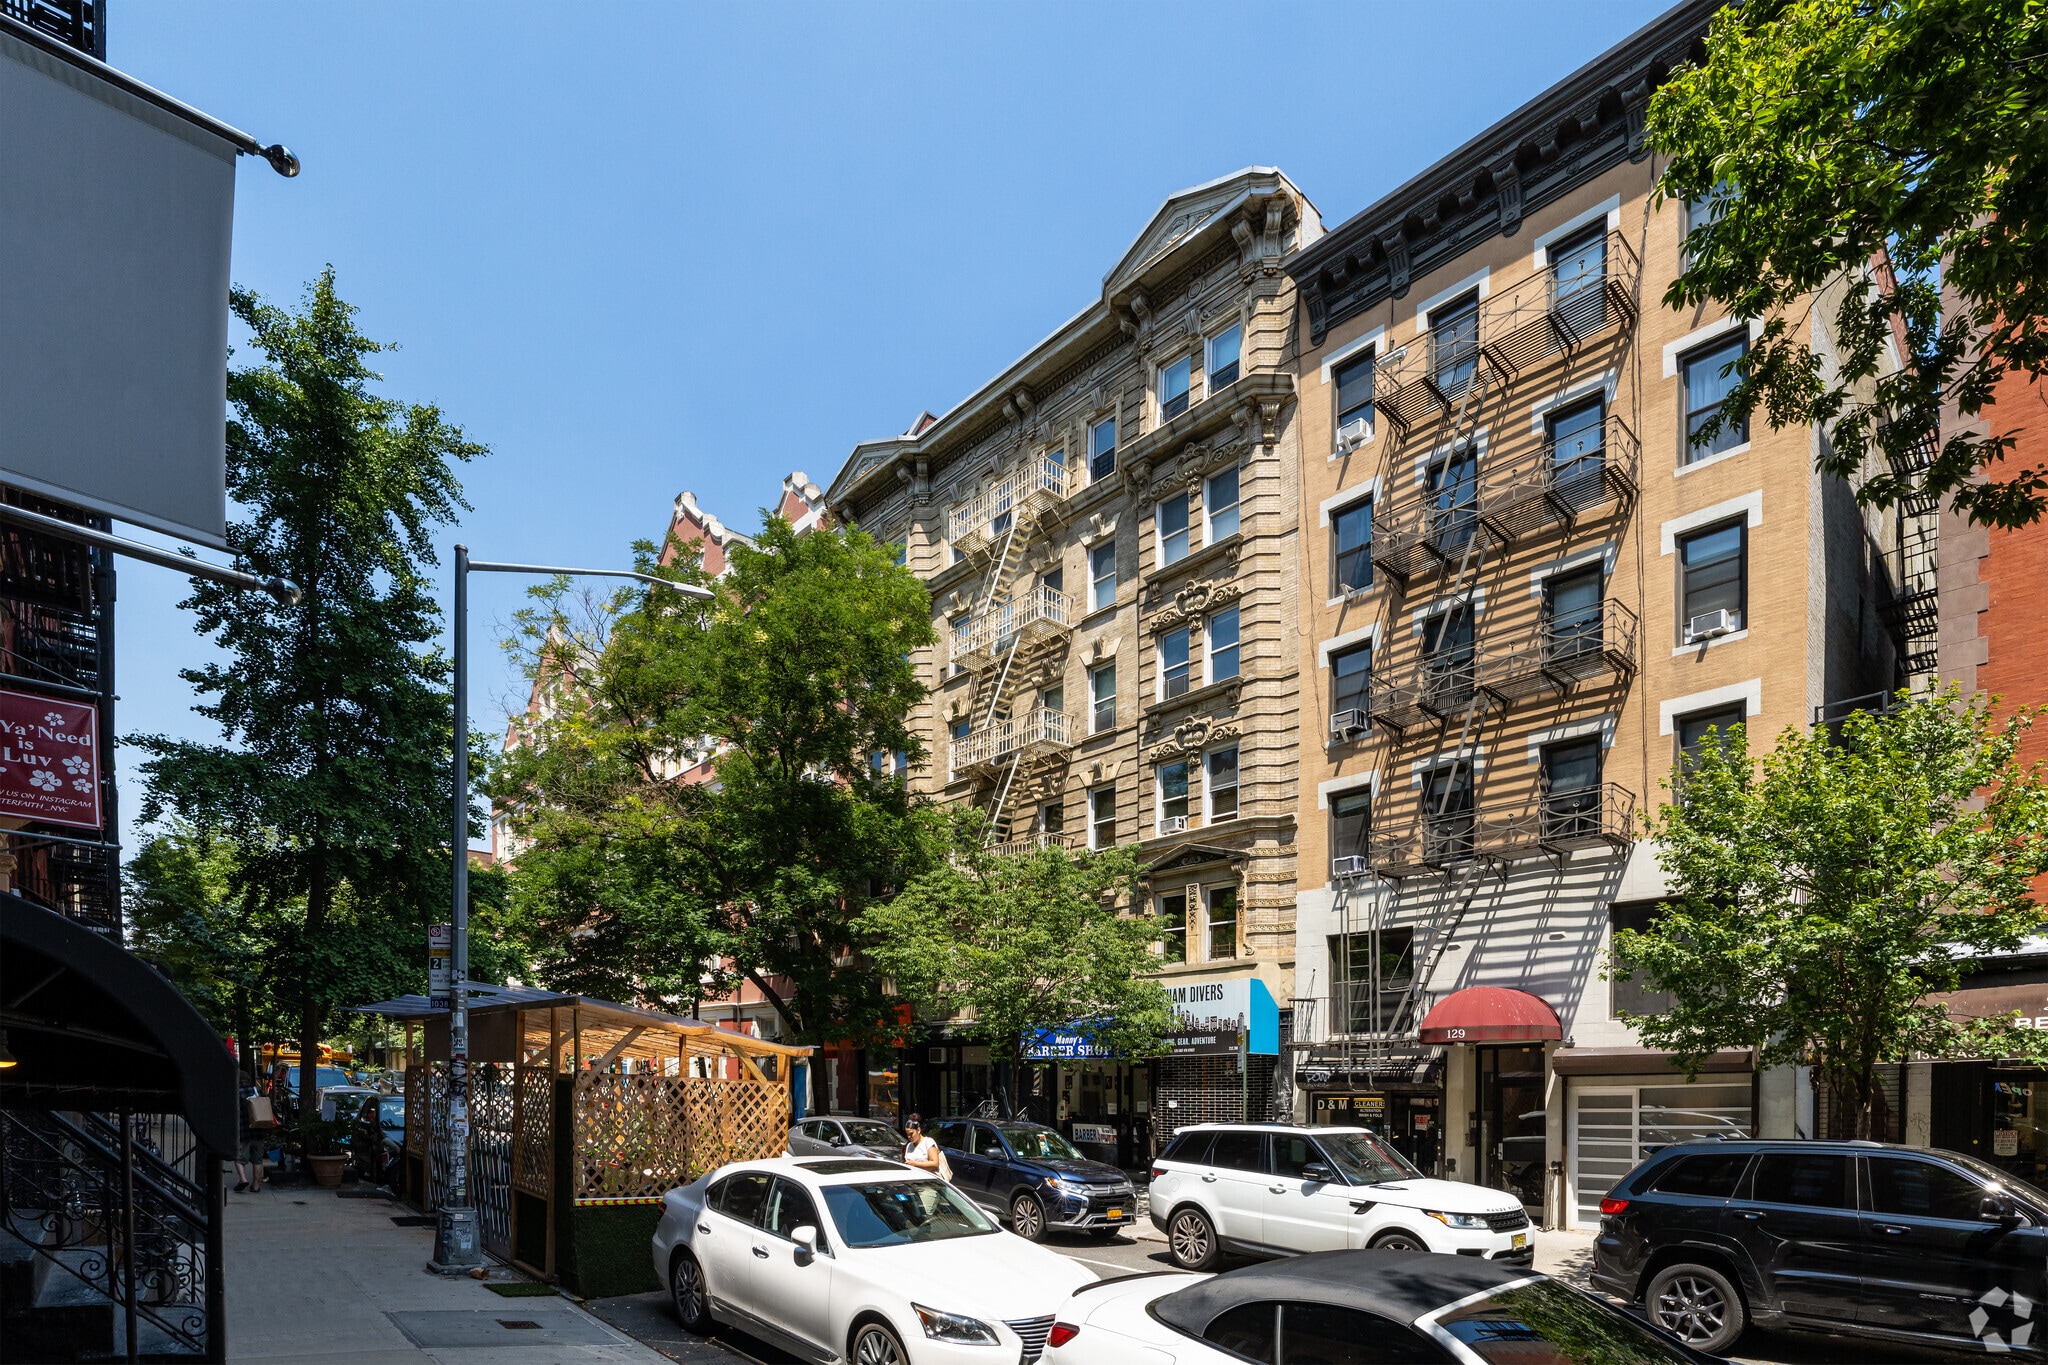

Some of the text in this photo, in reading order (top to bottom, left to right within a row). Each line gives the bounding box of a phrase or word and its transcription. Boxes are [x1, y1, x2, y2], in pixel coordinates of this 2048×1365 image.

[18, 737, 34, 750] is
[3, 747, 52, 767] Luv
[21, 792, 35, 800] ON
[39, 795, 92, 808] INSTAGRAM
[433, 958, 439, 969] 2
[1190, 983, 1223, 1002] DIVERS
[1447, 1028, 1465, 1039] 129
[1055, 1035, 1083, 1046] Manny's
[1317, 1100, 1347, 1110] D & M
[1074, 1128, 1097, 1140] BARBER
